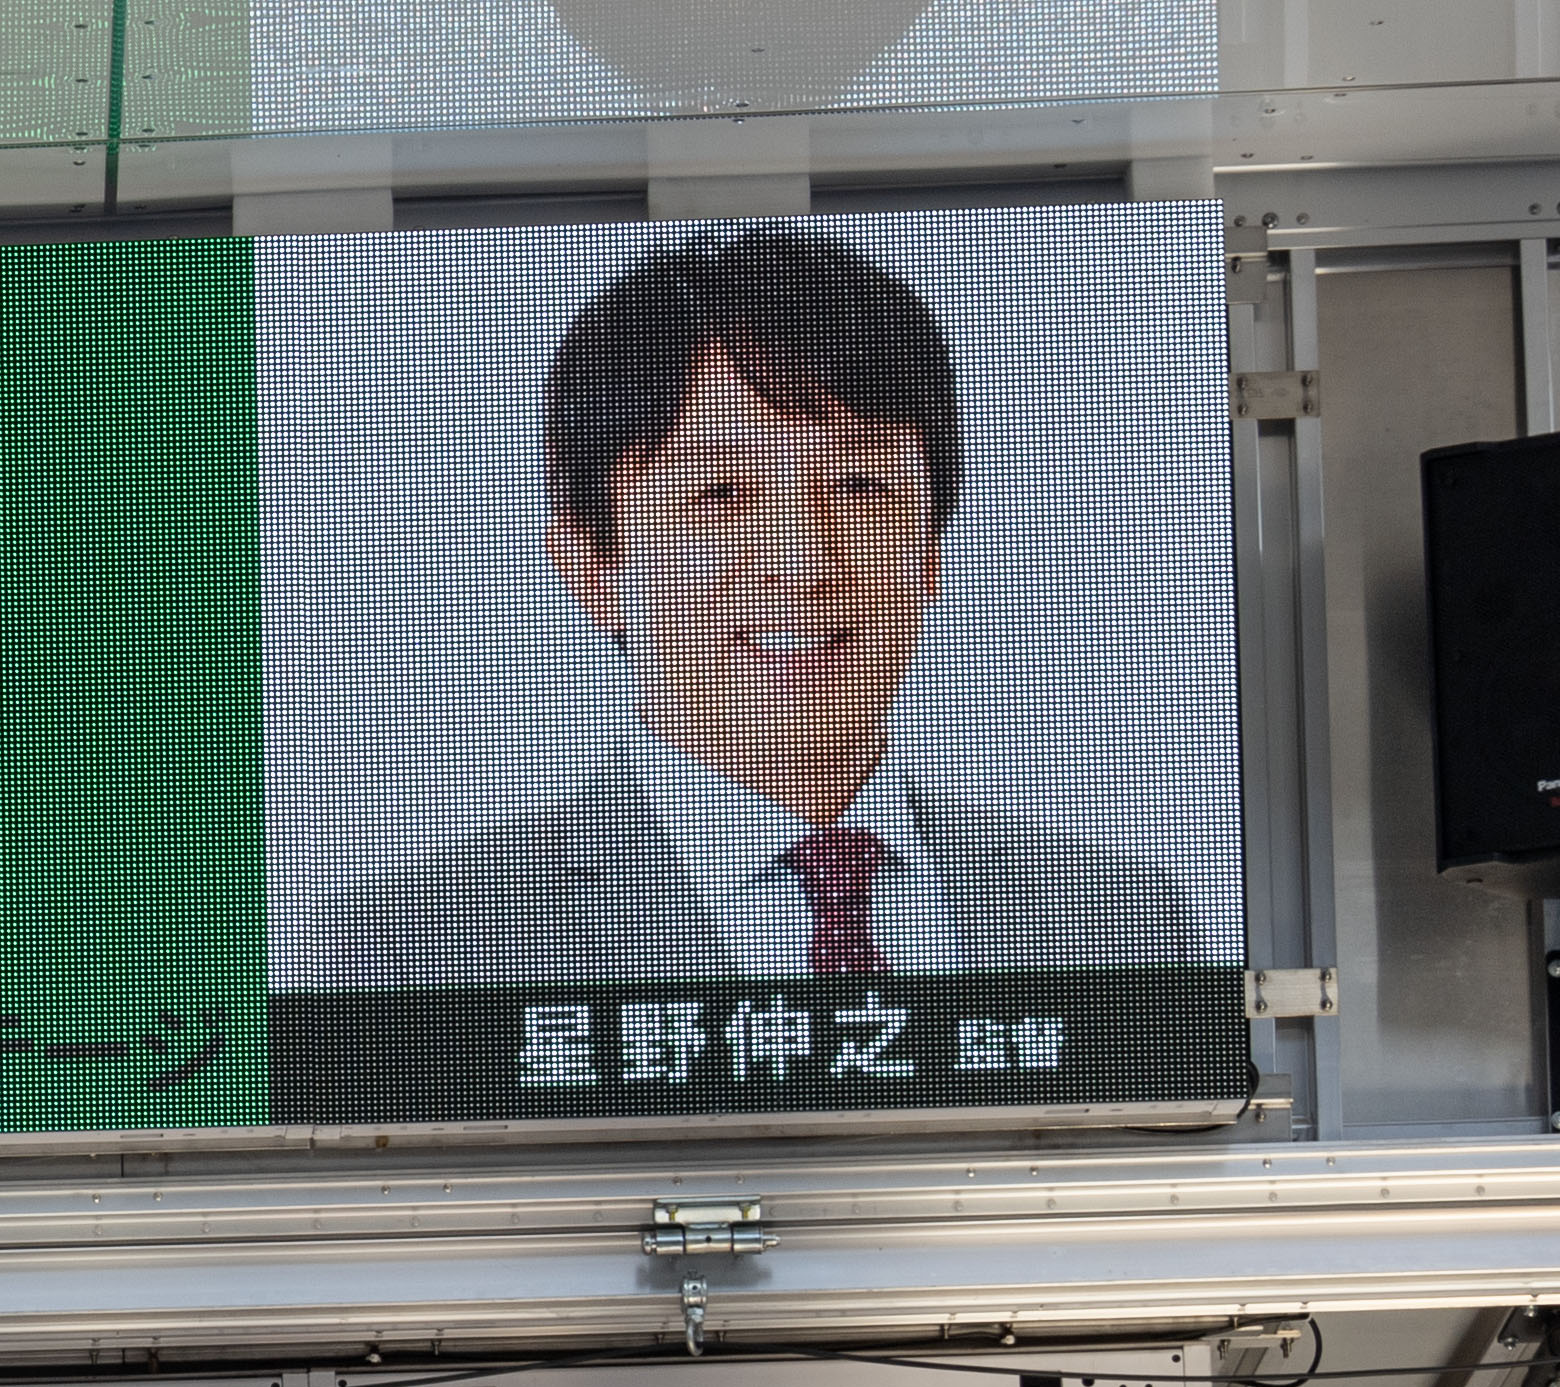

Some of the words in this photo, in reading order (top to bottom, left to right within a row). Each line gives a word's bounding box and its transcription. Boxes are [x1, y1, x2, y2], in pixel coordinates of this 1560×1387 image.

[520, 992, 915, 1088] 星野伸之
[953, 1017, 1064, 1070] 監督
